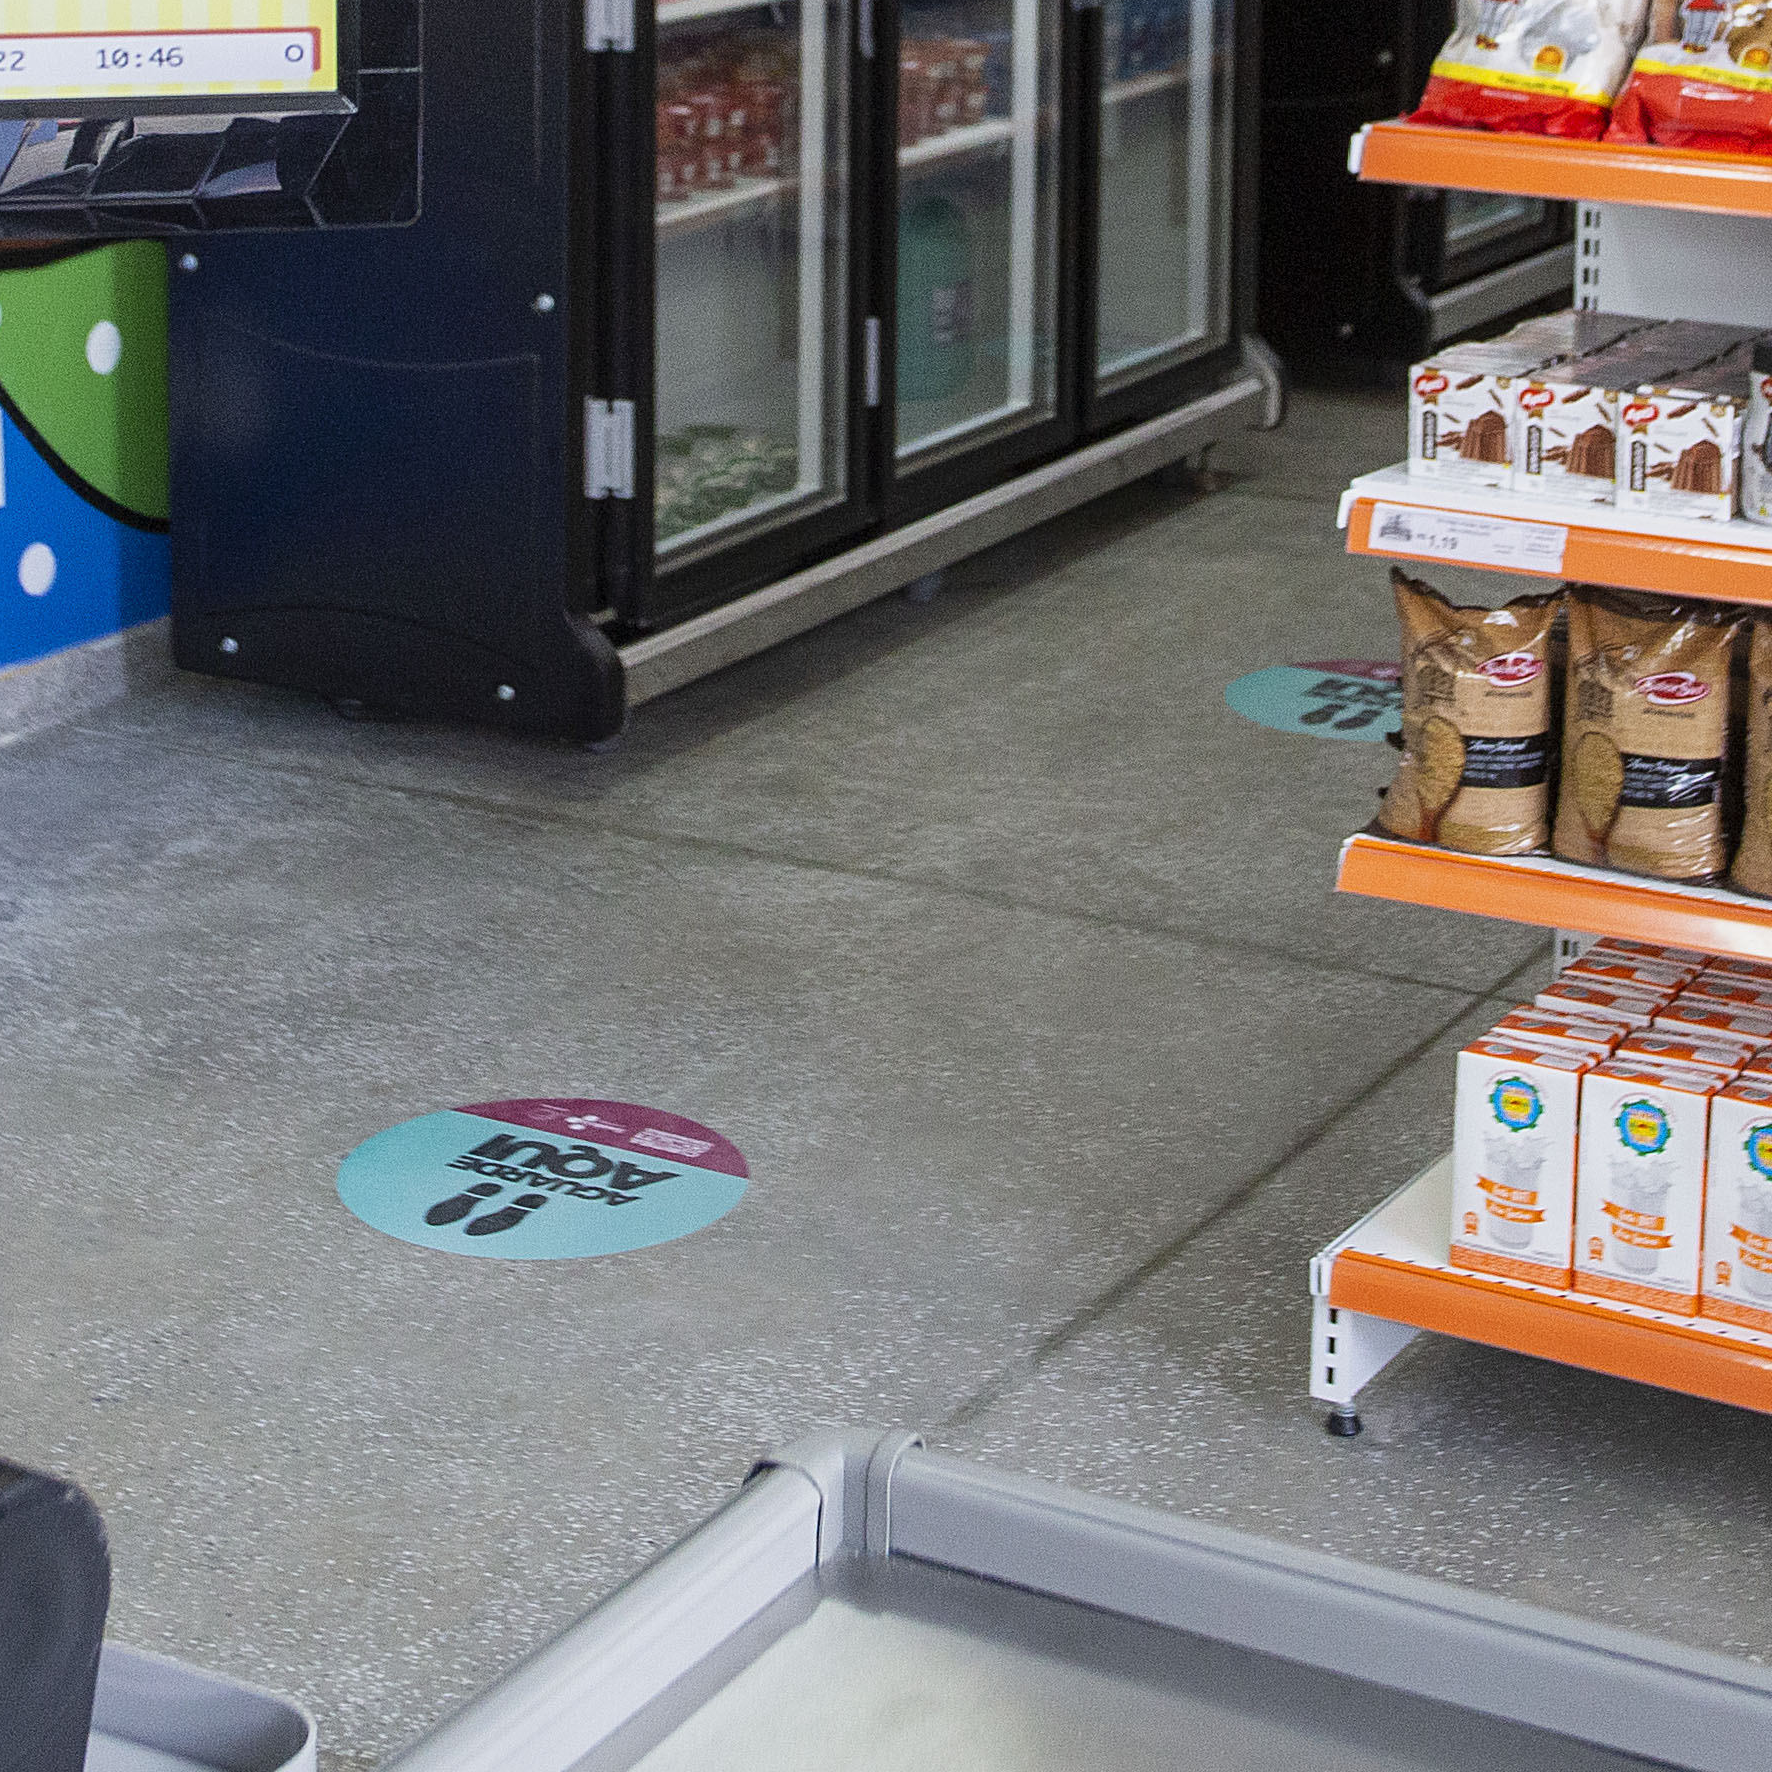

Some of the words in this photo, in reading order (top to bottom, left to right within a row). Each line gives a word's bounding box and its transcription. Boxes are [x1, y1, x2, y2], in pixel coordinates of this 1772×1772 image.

[95, 44, 184, 70] 10:46
[444, 1154, 645, 1208] AGUARDE
[456, 1132, 683, 1191] AQUI
